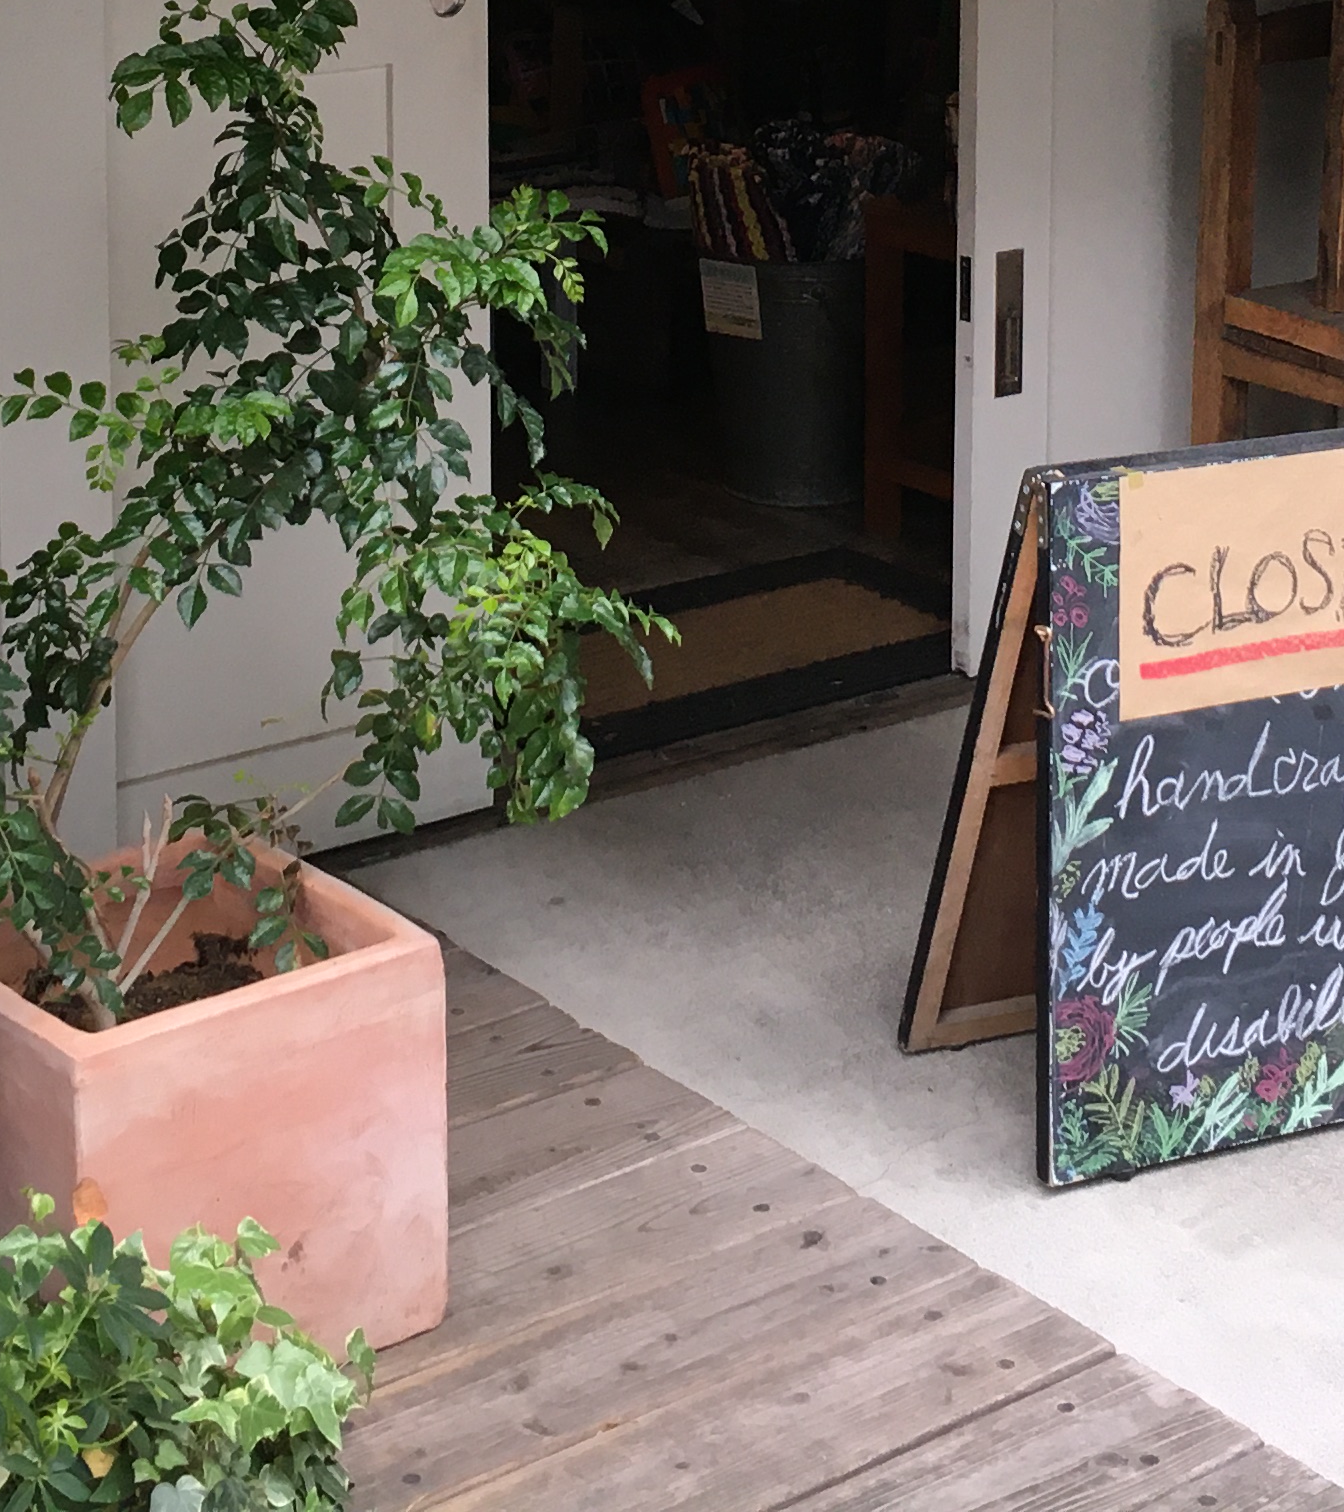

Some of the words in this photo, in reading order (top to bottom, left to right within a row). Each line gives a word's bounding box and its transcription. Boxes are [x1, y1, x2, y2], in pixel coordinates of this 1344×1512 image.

[1082, 821, 1236, 900] made
[1250, 828, 1306, 879] in
[1077, 928, 1156, 1005] by
[1154, 880, 1287, 995] people
